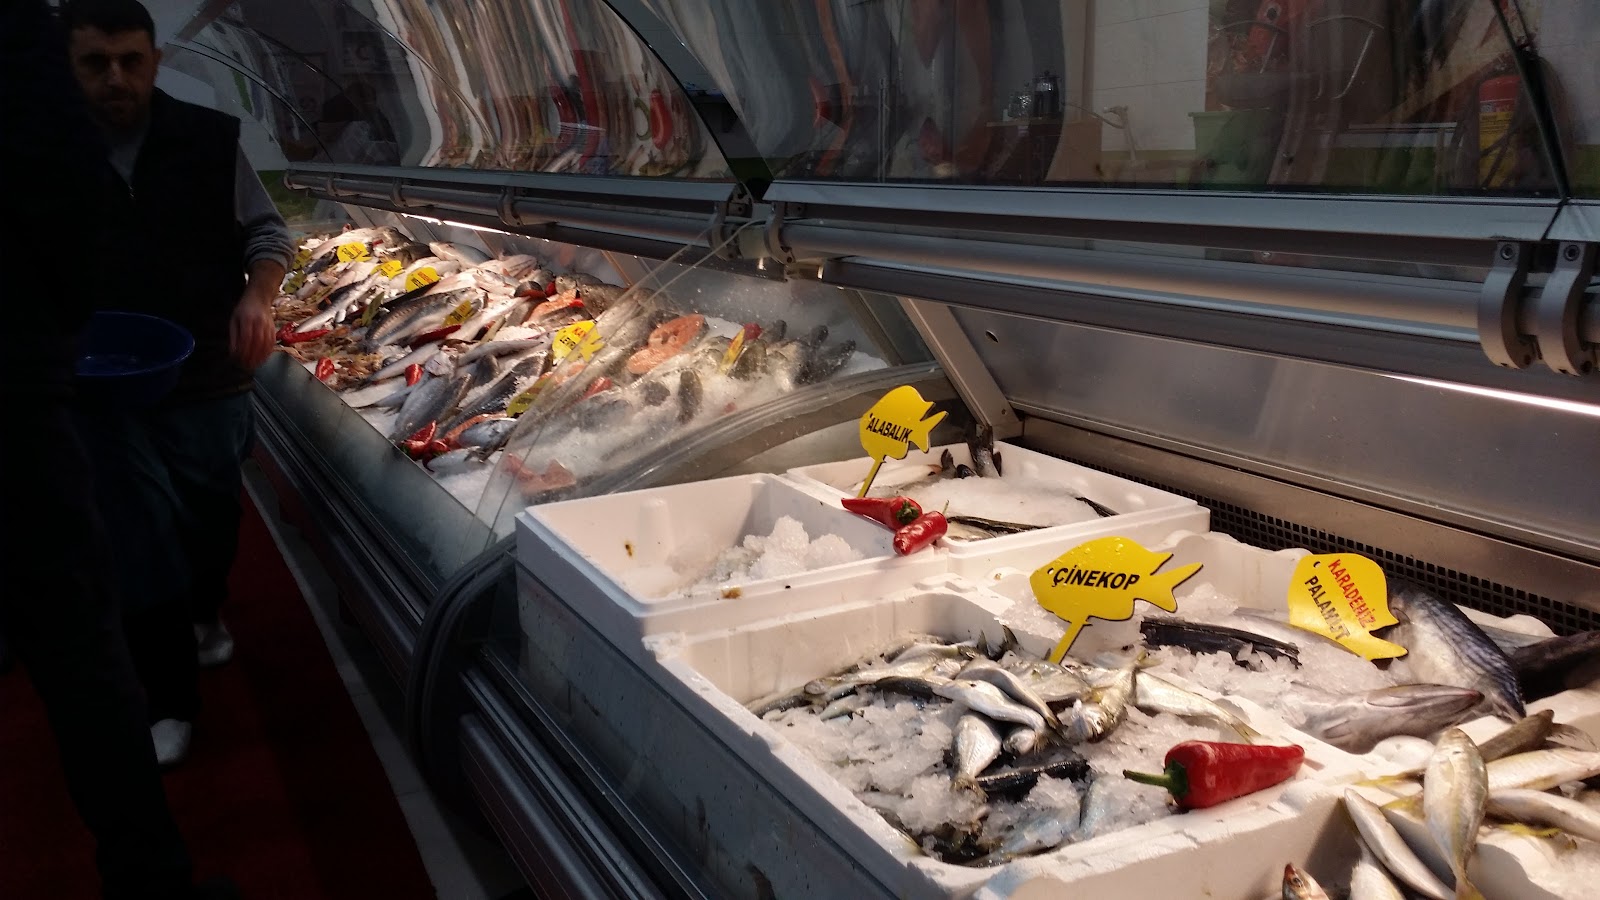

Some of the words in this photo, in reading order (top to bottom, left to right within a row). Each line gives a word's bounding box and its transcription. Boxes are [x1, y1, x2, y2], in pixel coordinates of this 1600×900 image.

[866, 417, 913, 443] ALABALIK
[1052, 565, 1140, 590] ÇİNEKOP
[1328, 559, 1376, 628] KARADENİZ
[1305, 576, 1350, 640] PALAMUT
